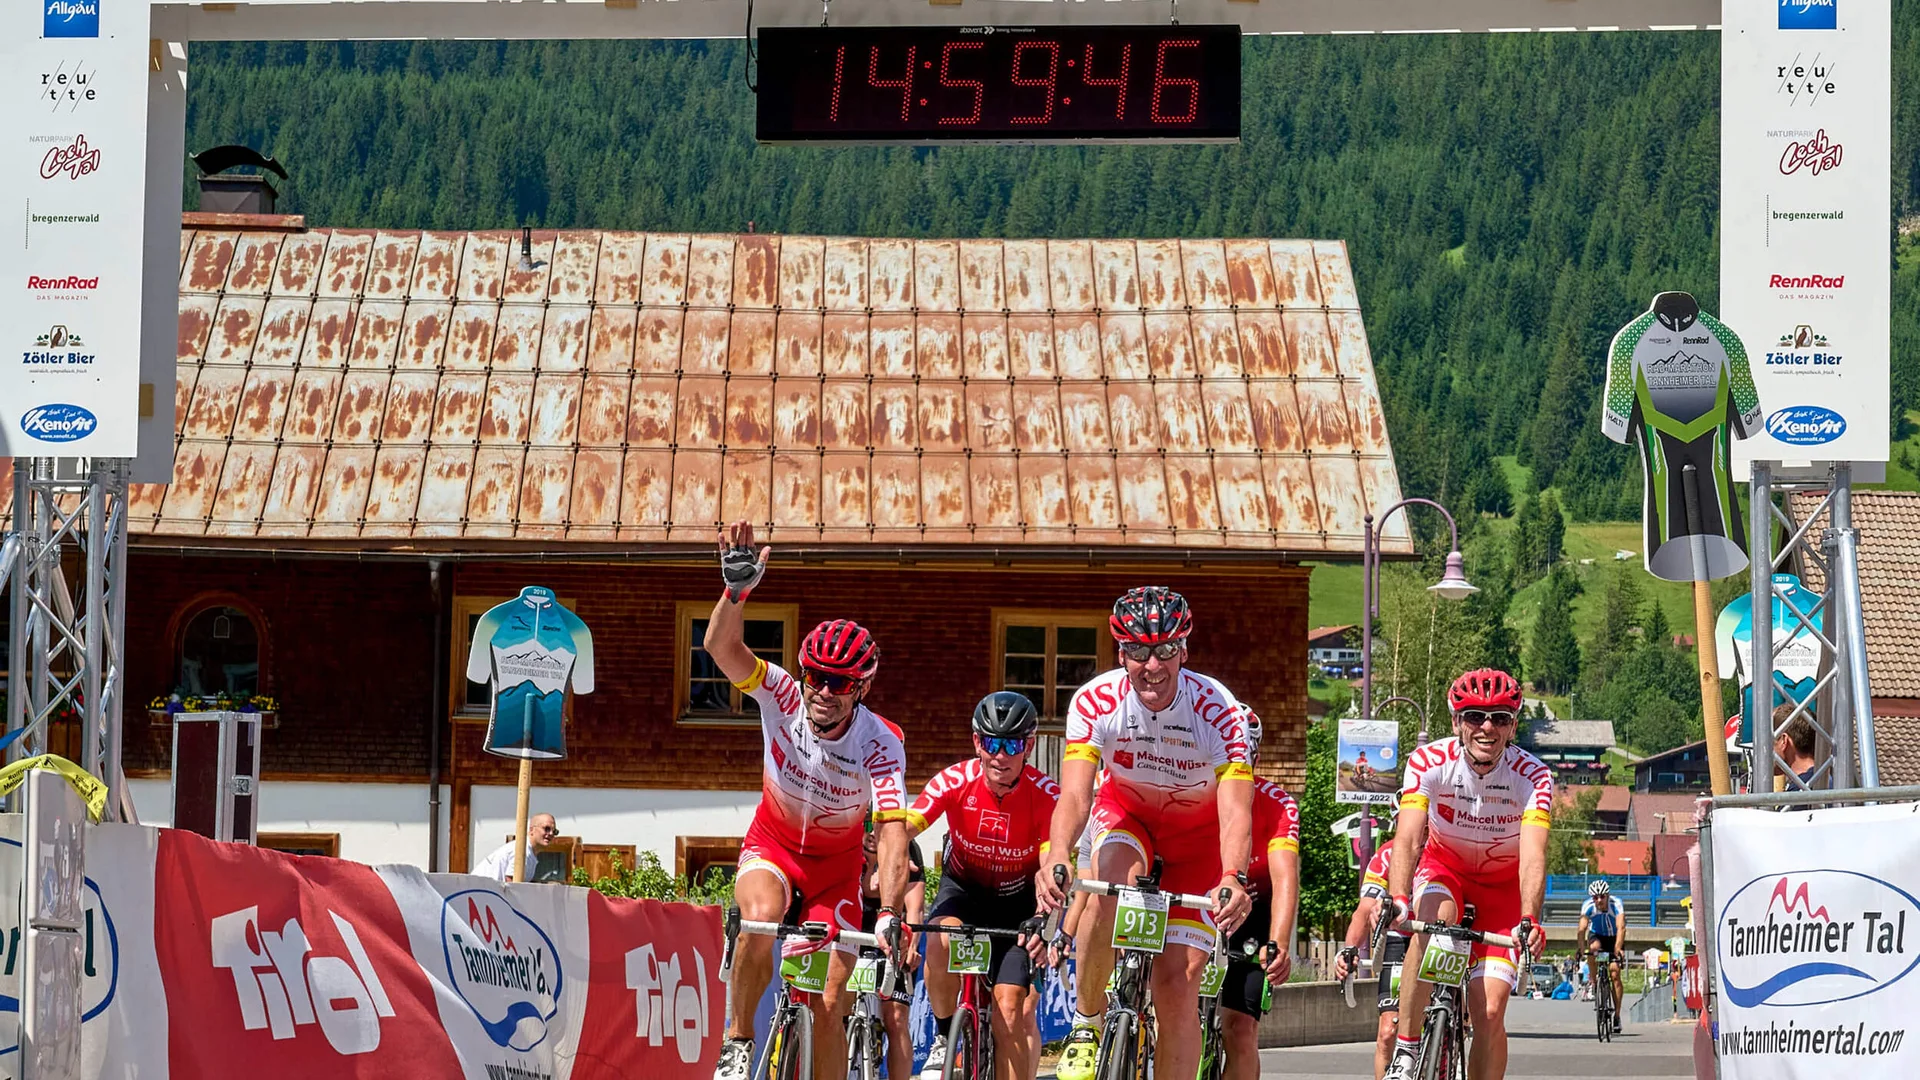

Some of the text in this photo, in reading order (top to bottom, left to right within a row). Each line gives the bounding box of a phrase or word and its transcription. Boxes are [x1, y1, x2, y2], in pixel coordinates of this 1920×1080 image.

[47, 0, 96, 23] Allgäu
[29, 135, 74, 143] NATURPARK
[1767, 130, 1814, 138] NATURPARK
[32, 214, 99, 225] bregenzerwald
[1773, 211, 1844, 222] bregenzerwald
[27, 276, 99, 289] RennRad
[1769, 274, 1845, 288] RennRad
[22, 352, 96, 364] Zötler Bier
[1765, 352, 1843, 366] Zötler Bier
[1136, 750, 1175, 768] Marcel
[785, 759, 828, 791] Marcel
[1341, 793, 1390, 802] 3. Juli 2022
[1457, 810, 1495, 825] Marcel
[954, 829, 1034, 858] Marcel Wüst
[1123, 909, 1158, 936] 913
[1127, 936, 1161, 946] KARL-HEINZ
[1728, 910, 1906, 958] Tannheimer Tal
[956, 941, 984, 961] 842
[1427, 949, 1466, 975] 1003
[795, 974, 821, 987] MARCEL
[1435, 971, 1457, 981] ULRICH
